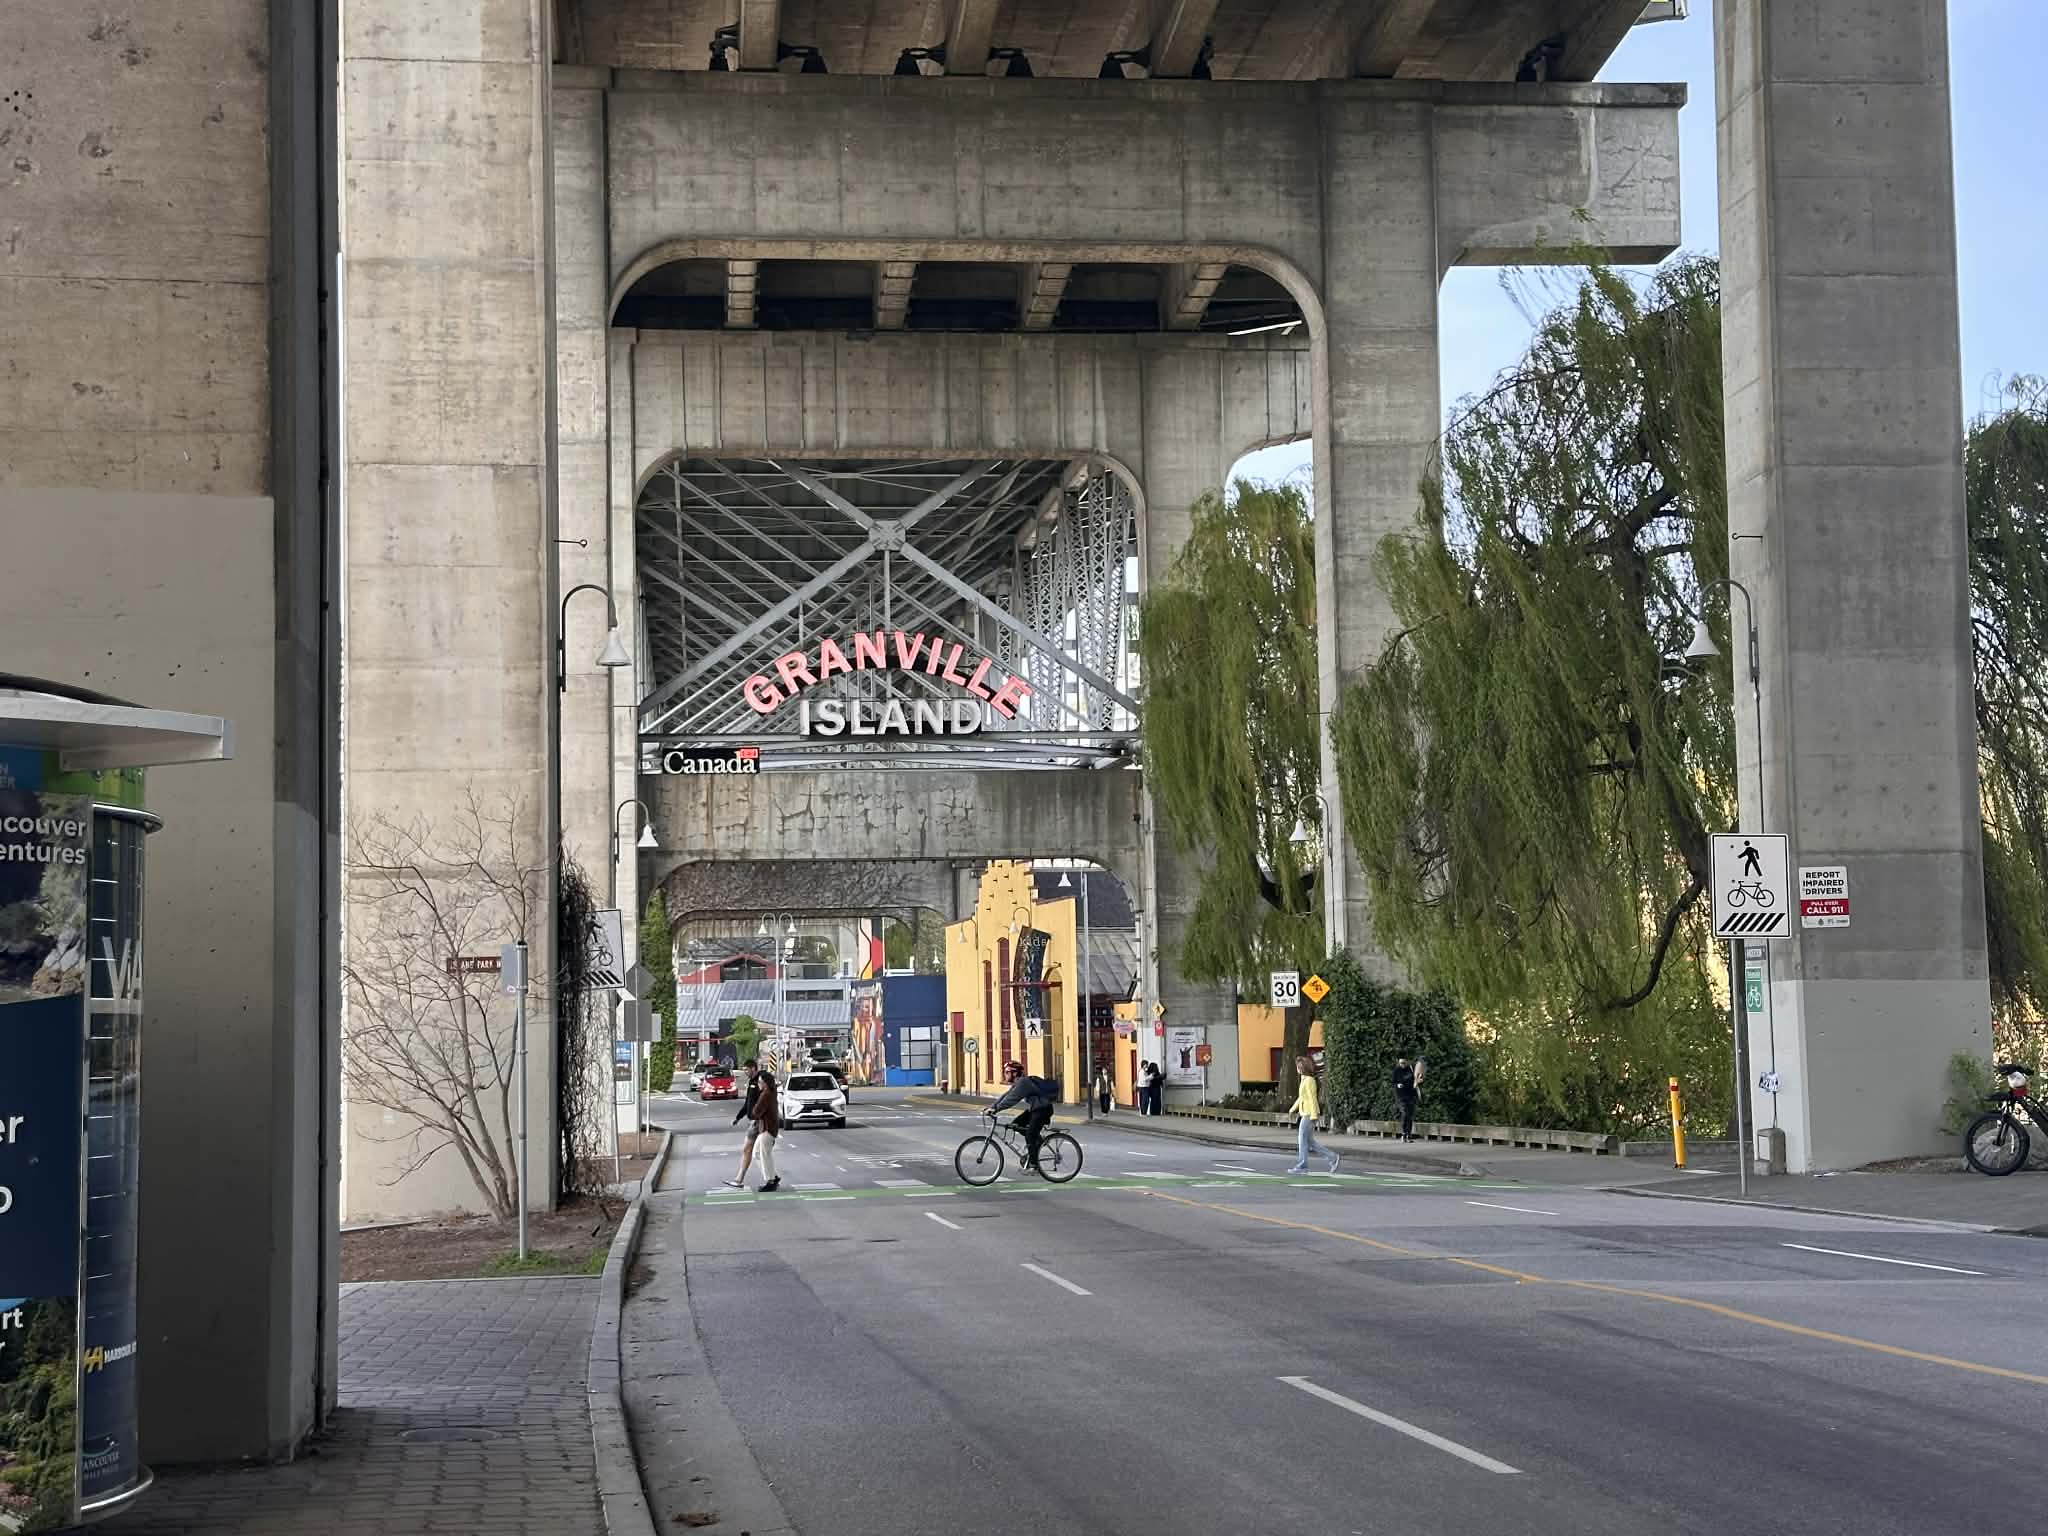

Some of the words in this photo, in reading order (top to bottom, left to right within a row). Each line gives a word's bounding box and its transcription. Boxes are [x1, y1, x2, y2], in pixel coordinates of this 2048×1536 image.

[743, 631, 1033, 720] GRANVILLE
[801, 699, 982, 737] ISLAND
[663, 749, 758, 774] Canada
[1802, 879, 1844, 887] IMPAIRED
[1805, 887, 1843, 895] DRIVERS
[1806, 906, 1830, 914] CALL
[477, 960, 495, 969] PARK
[1274, 981, 1297, 997] 30
